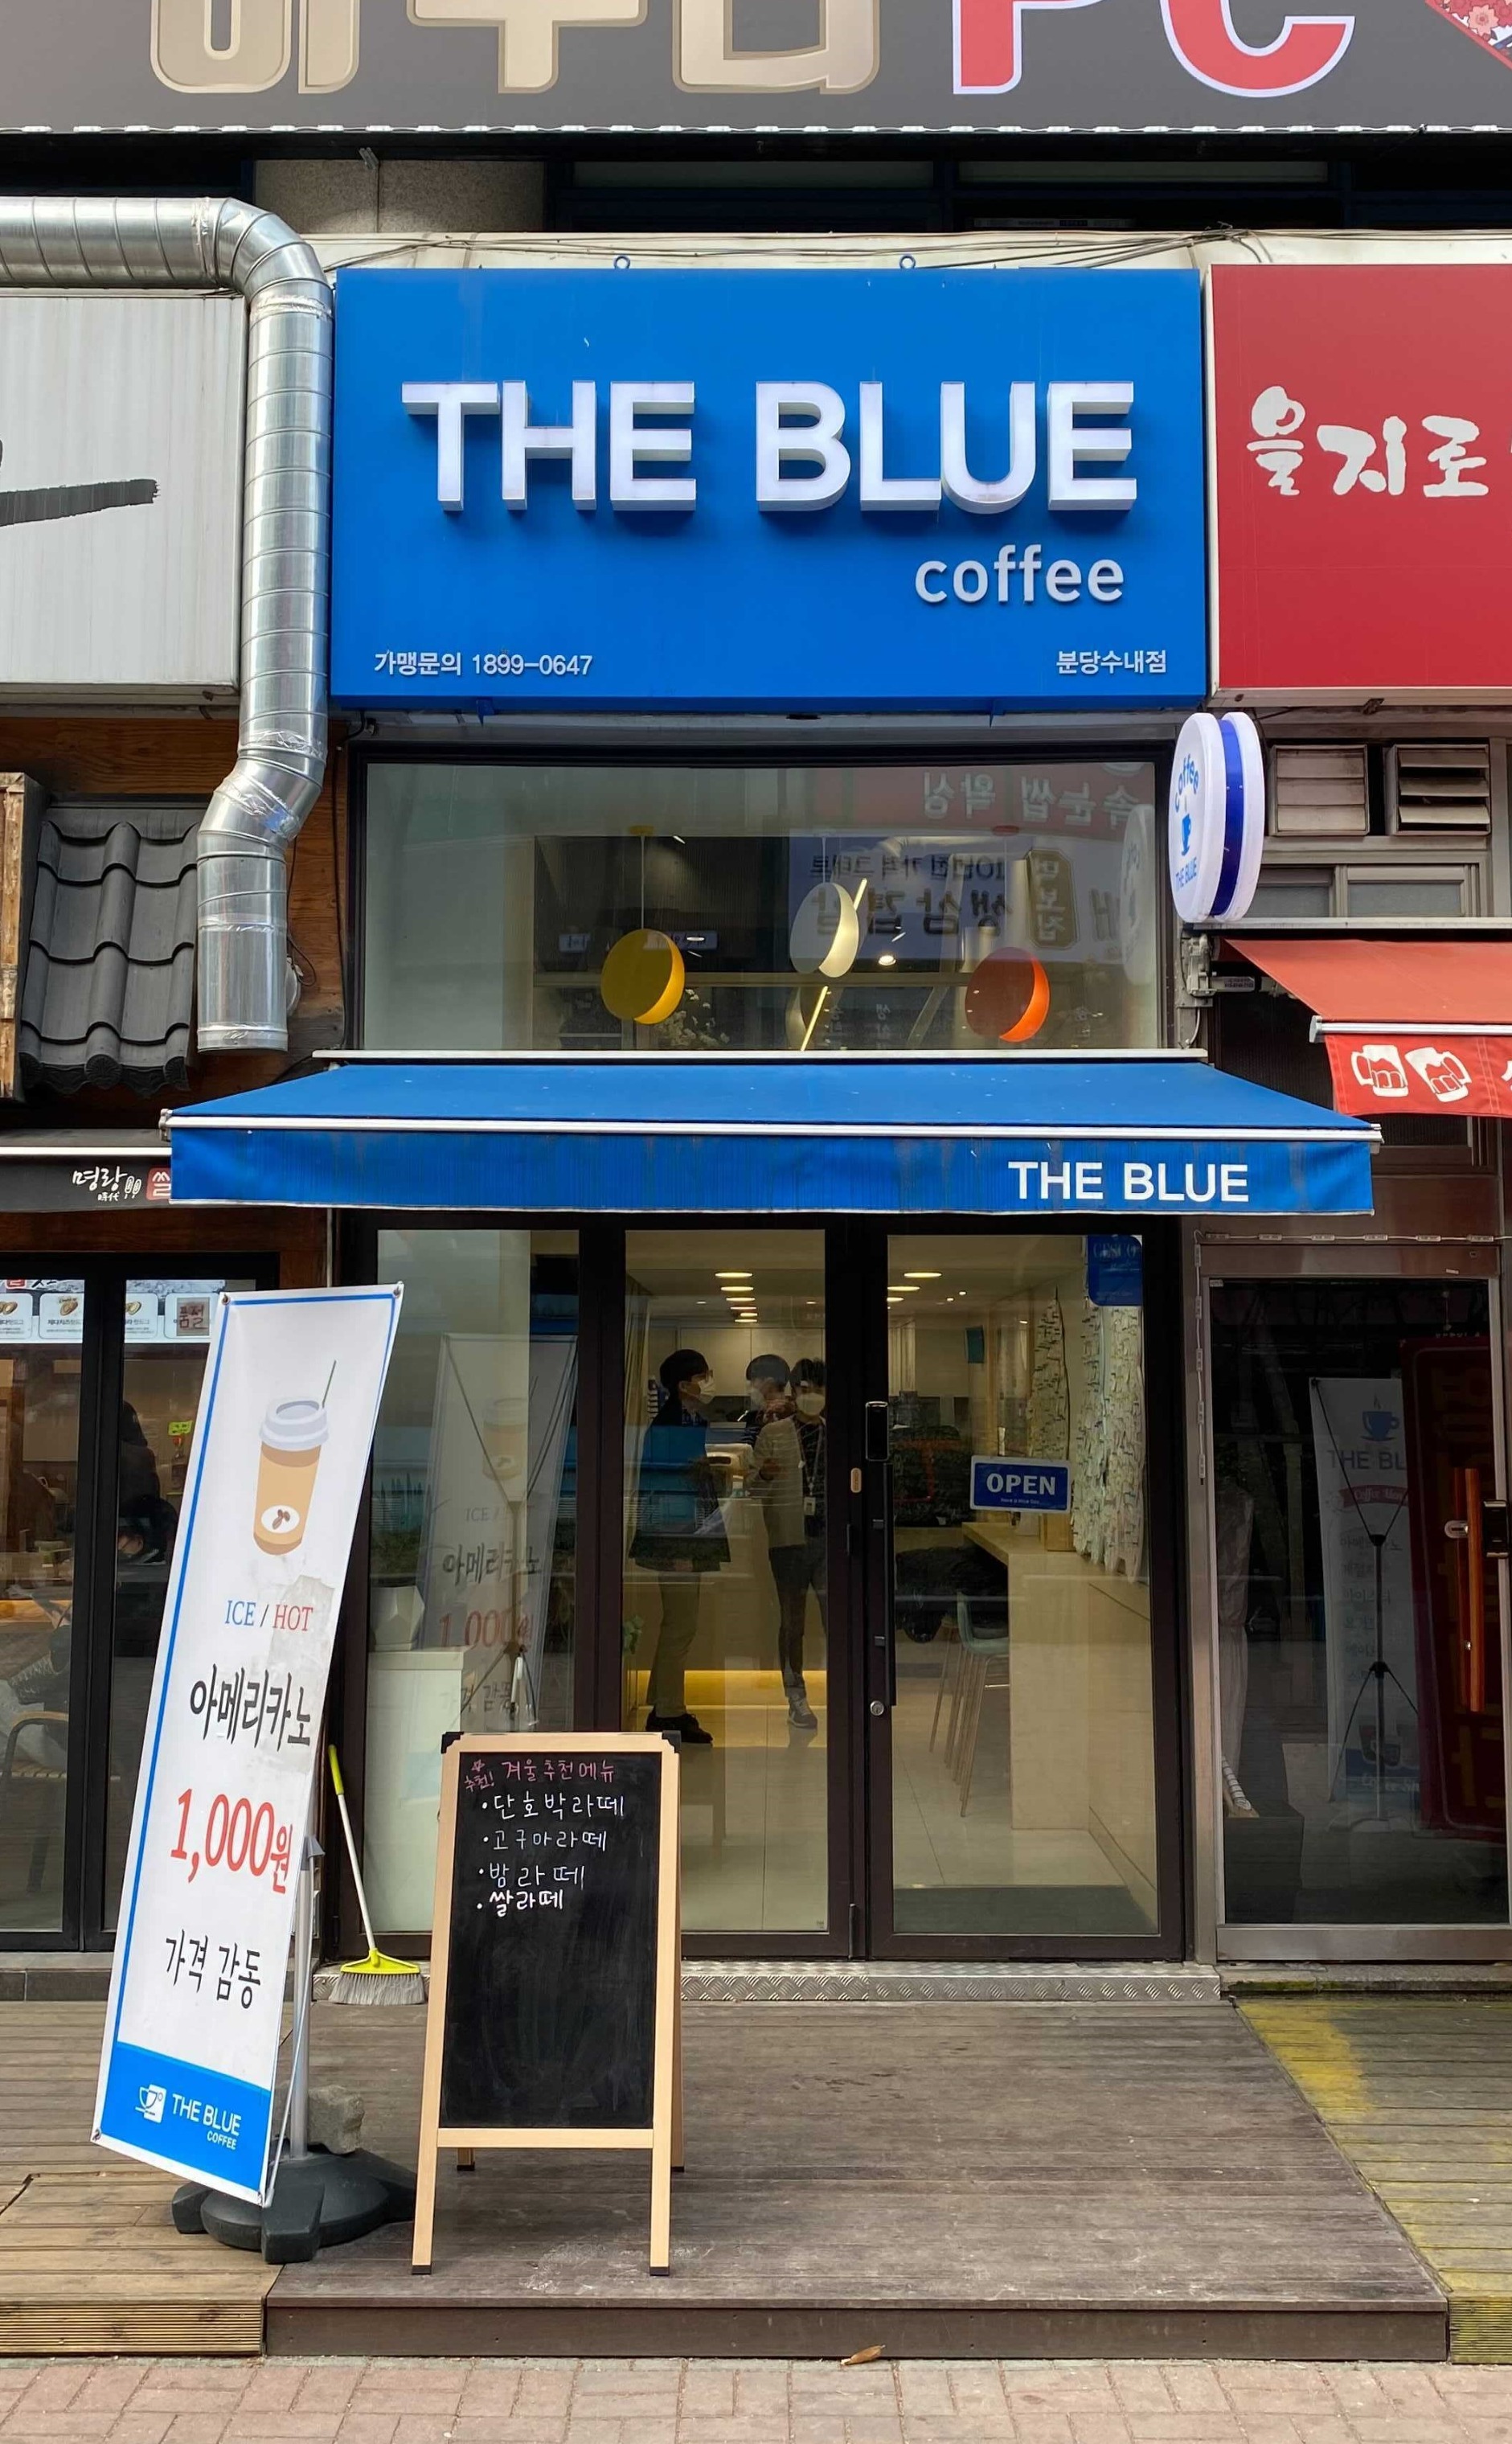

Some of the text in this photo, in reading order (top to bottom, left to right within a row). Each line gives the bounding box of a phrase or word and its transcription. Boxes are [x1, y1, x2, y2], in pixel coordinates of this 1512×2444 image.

[401, 380, 1138, 515] THE BLUE
[1246, 386, 1489, 497] 을지로
[914, 544, 1125, 605] coffee
[375, 651, 593, 677] 가맹문의 1899-0647
[1055, 649, 1168, 676] 분당수내점
[1008, 1162, 1249, 1203] THE BLUE
[986, 1473, 1055, 1495] OPEN
[224, 1599, 256, 1628] ICE
[272, 1604, 314, 1633] HOT
[190, 1663, 311, 1753] 아메리카노
[170, 1787, 293, 1895] 1,000원
[166, 1929, 261, 2010] 가격 감동
[172, 2093, 242, 2137] THE BLUE
[207, 2130, 237, 2151] COFFEE
